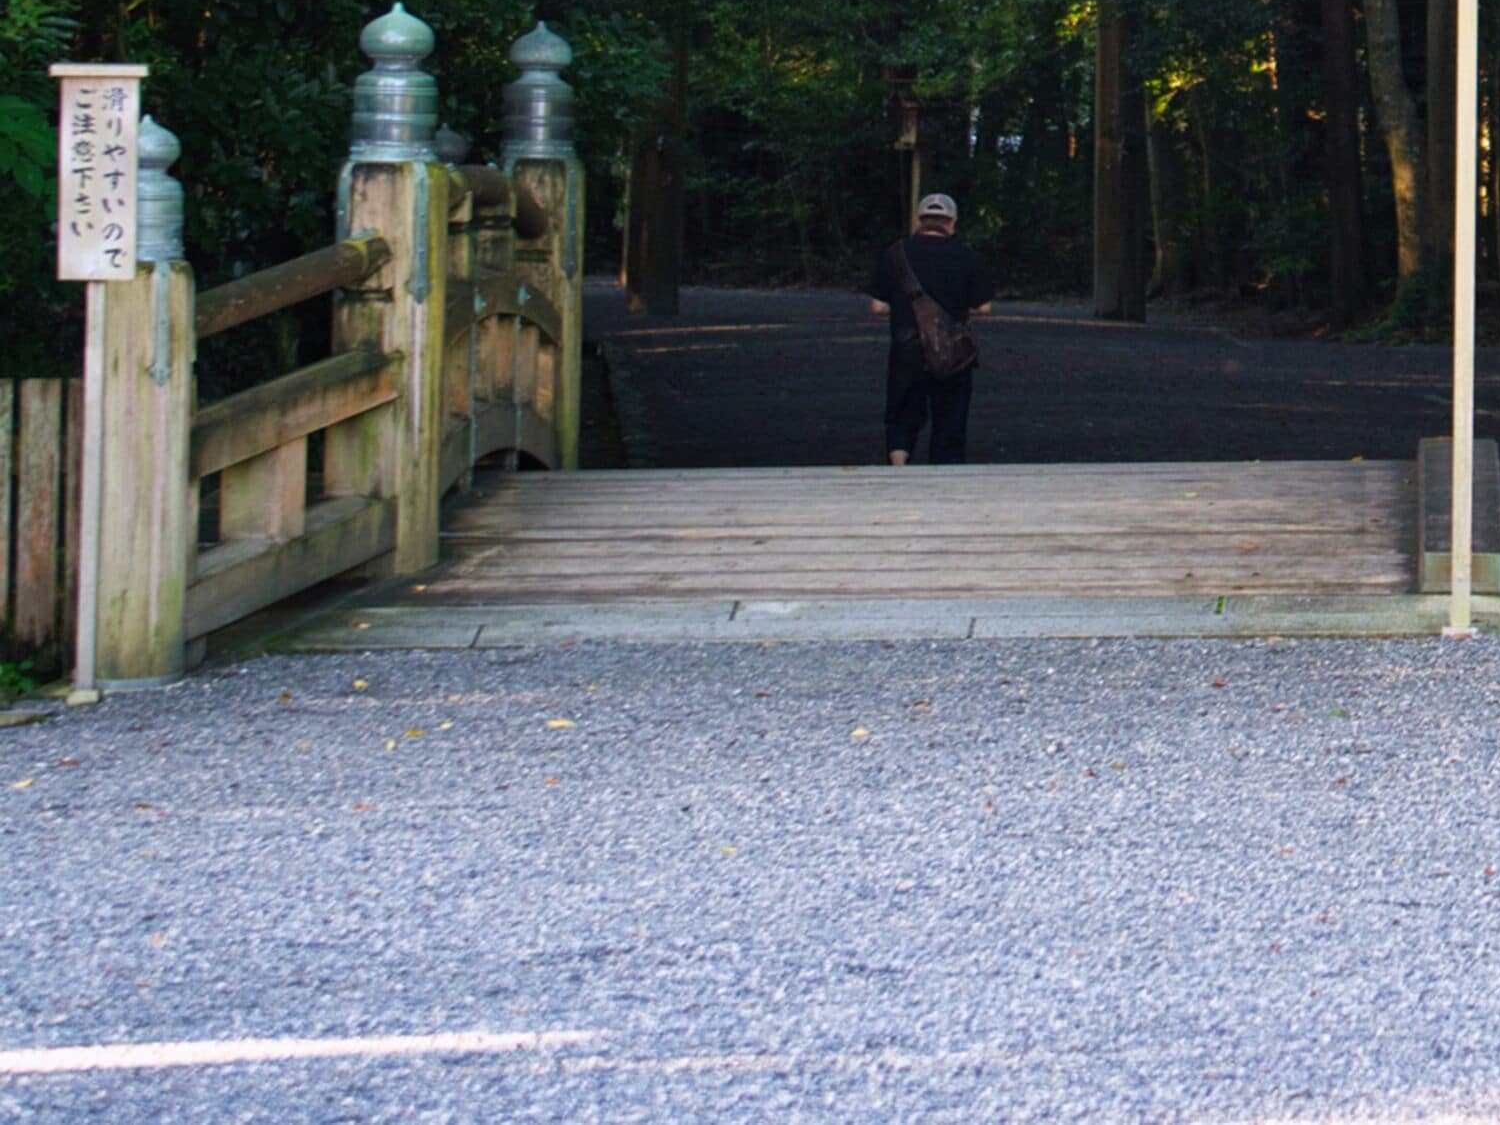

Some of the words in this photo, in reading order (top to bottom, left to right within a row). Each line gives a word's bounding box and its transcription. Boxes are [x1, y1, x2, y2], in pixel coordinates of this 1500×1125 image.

[70, 88, 97, 238] ご注意下さい
[101, 87, 128, 269] 滑りやすいので
